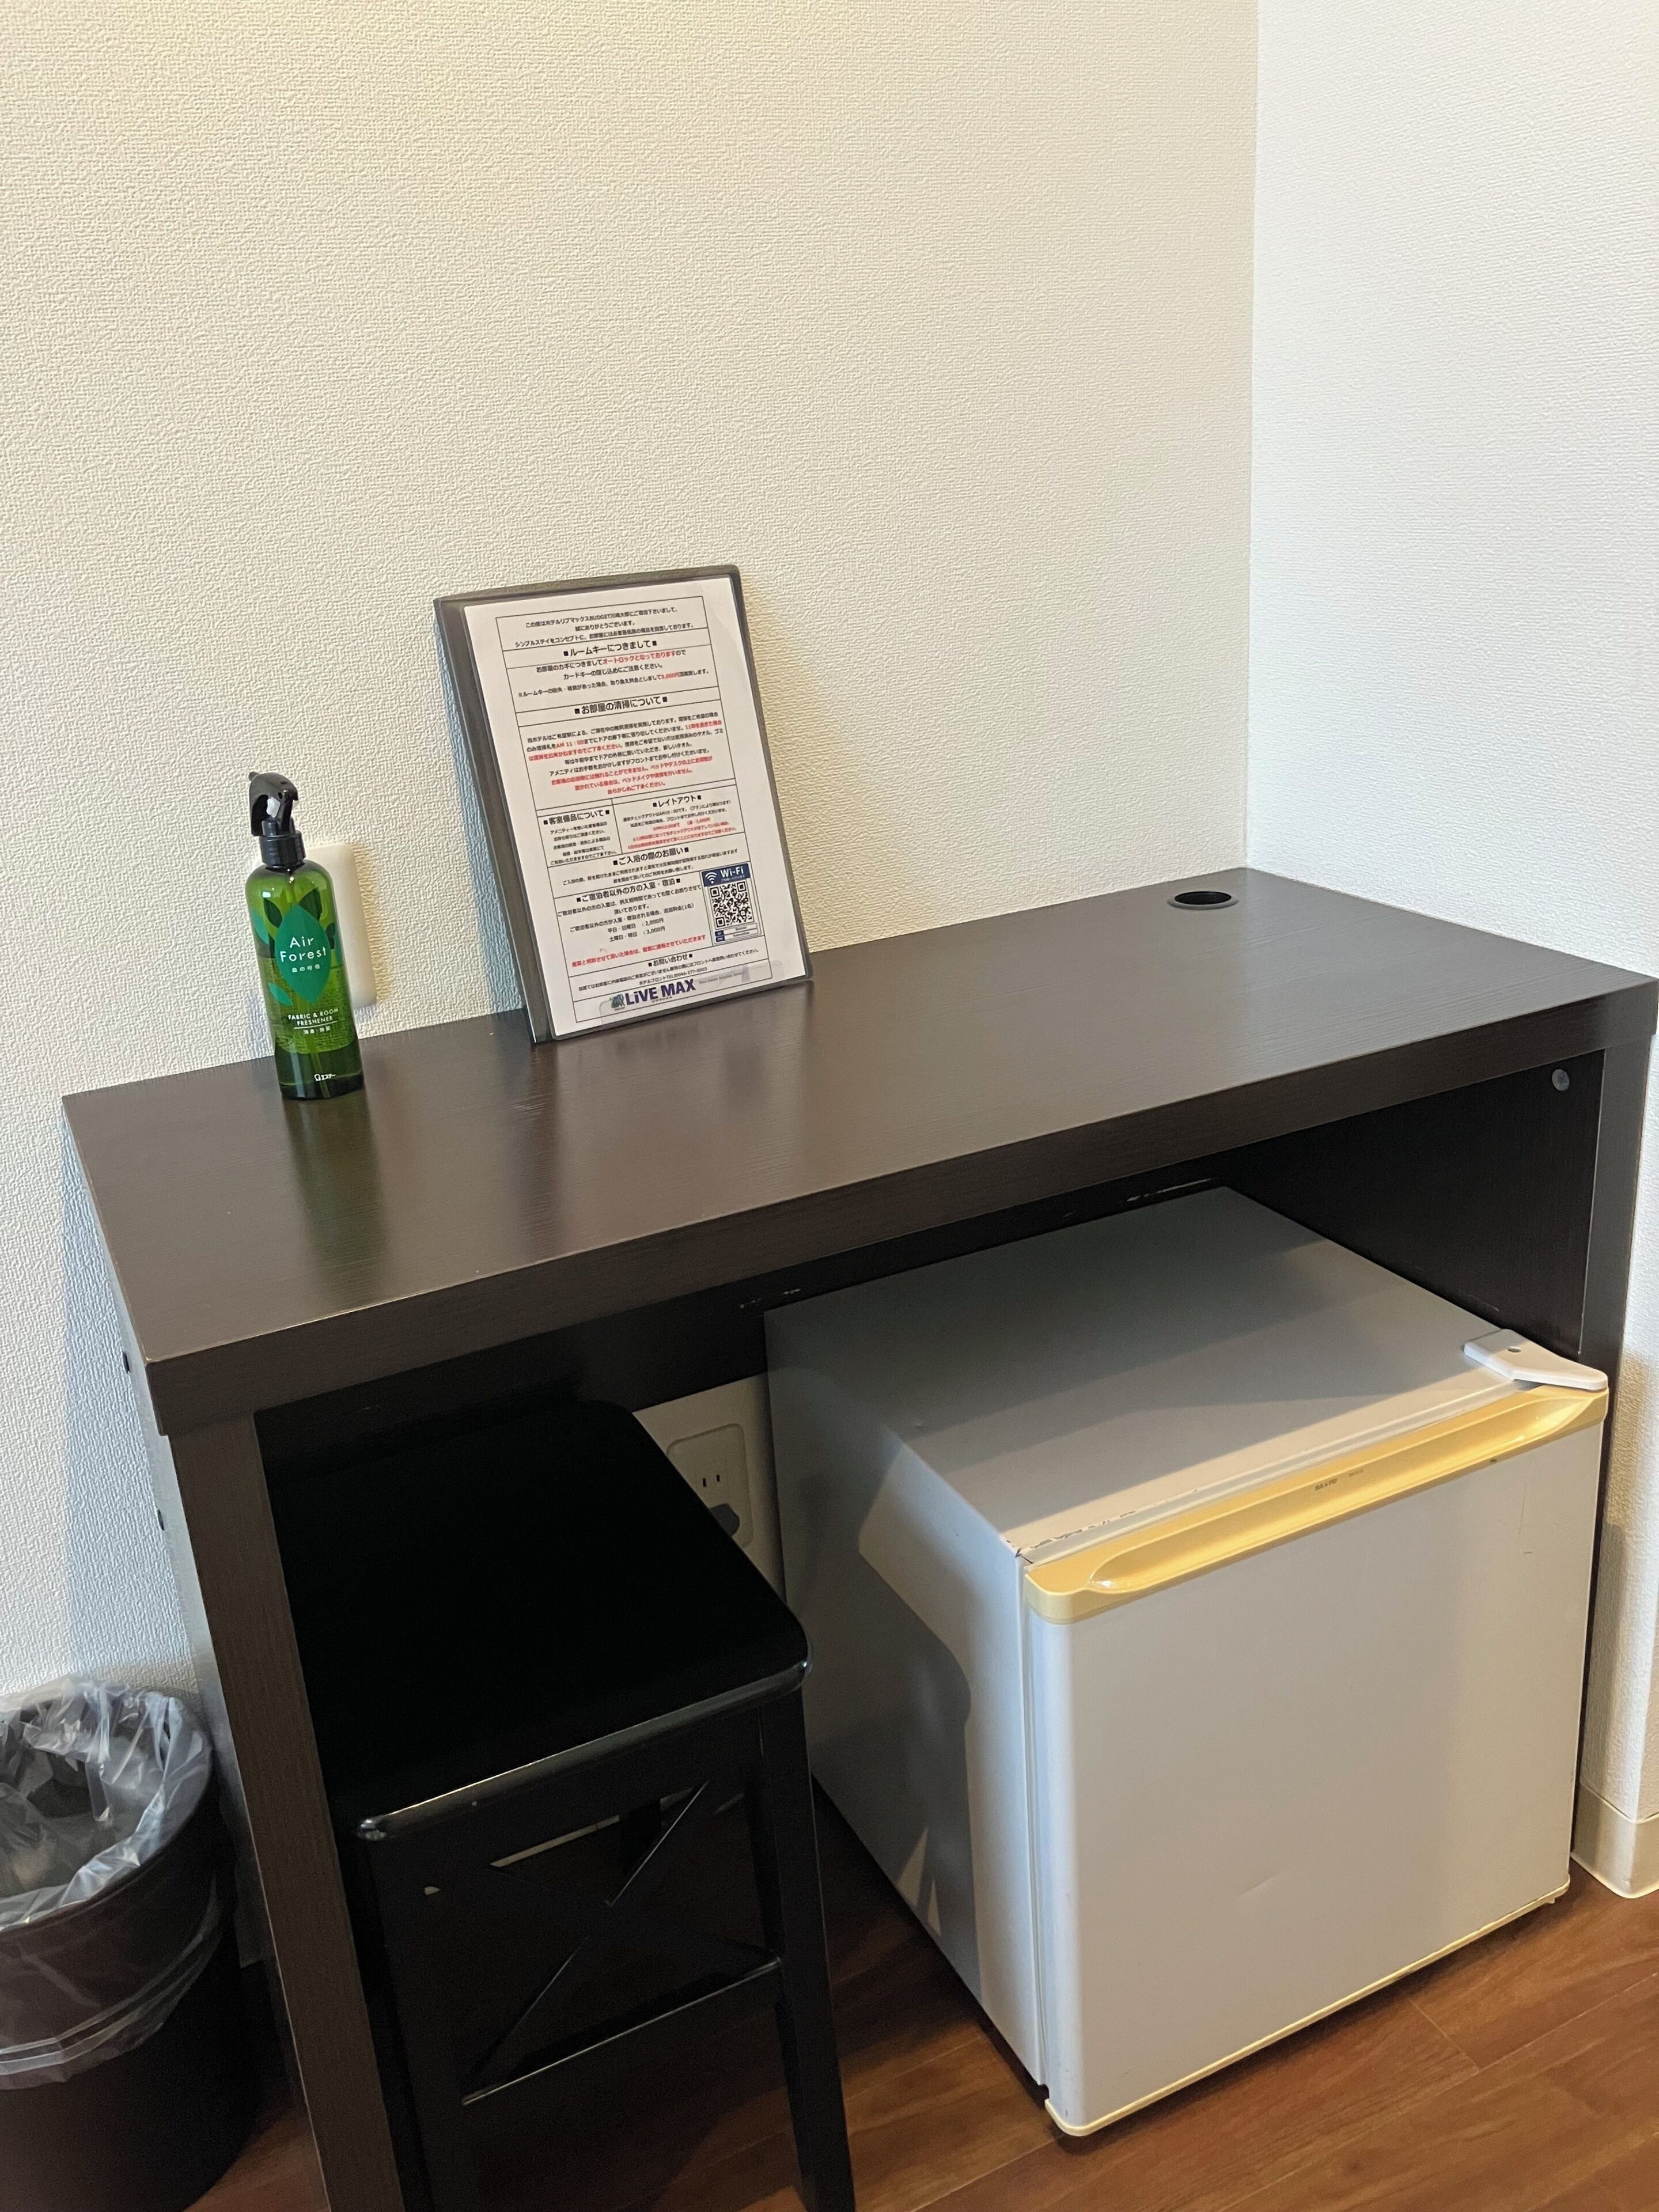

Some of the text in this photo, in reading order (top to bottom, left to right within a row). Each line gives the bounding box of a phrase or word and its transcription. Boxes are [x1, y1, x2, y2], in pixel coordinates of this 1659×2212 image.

[719, 865, 745, 878] Wi-Fi
[290, 936, 314, 948] Air
[280, 946, 326, 963] Forest
[624, 978, 696, 1006] LiVE MAX
[320, 1008, 339, 1016] ROOM
[297, 1016, 333, 1026] FRESHENER
